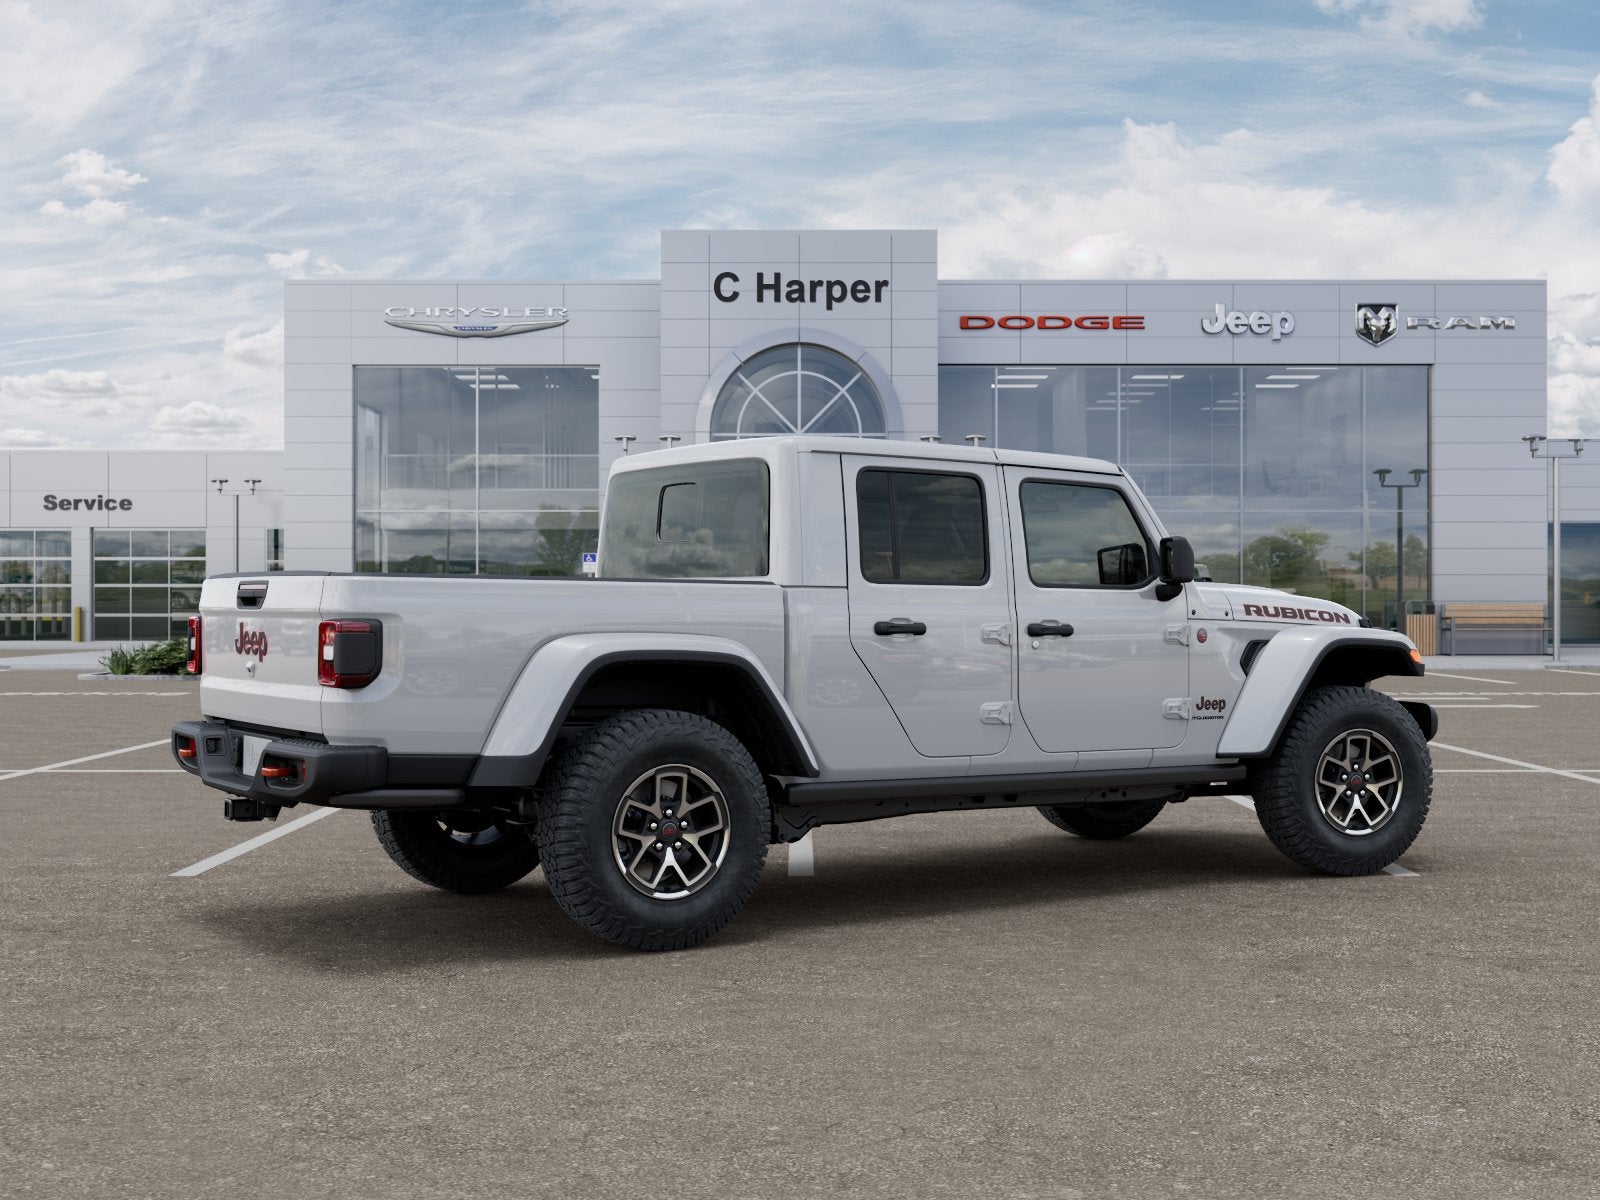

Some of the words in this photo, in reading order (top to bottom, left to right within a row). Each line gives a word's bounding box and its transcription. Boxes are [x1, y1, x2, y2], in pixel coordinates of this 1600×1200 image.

[713, 272, 740, 303] C
[757, 272, 890, 309] Harper
[384, 306, 568, 318] CHRYSLER
[959, 315, 1146, 330] DODGE
[1201, 303, 1295, 342] Jeep
[1407, 316, 1516, 330] RAM
[43, 494, 133, 511] Service
[1244, 603, 1350, 624] RUBICON
[235, 621, 268, 662] Jeep
[1195, 696, 1227, 712] Jeep
